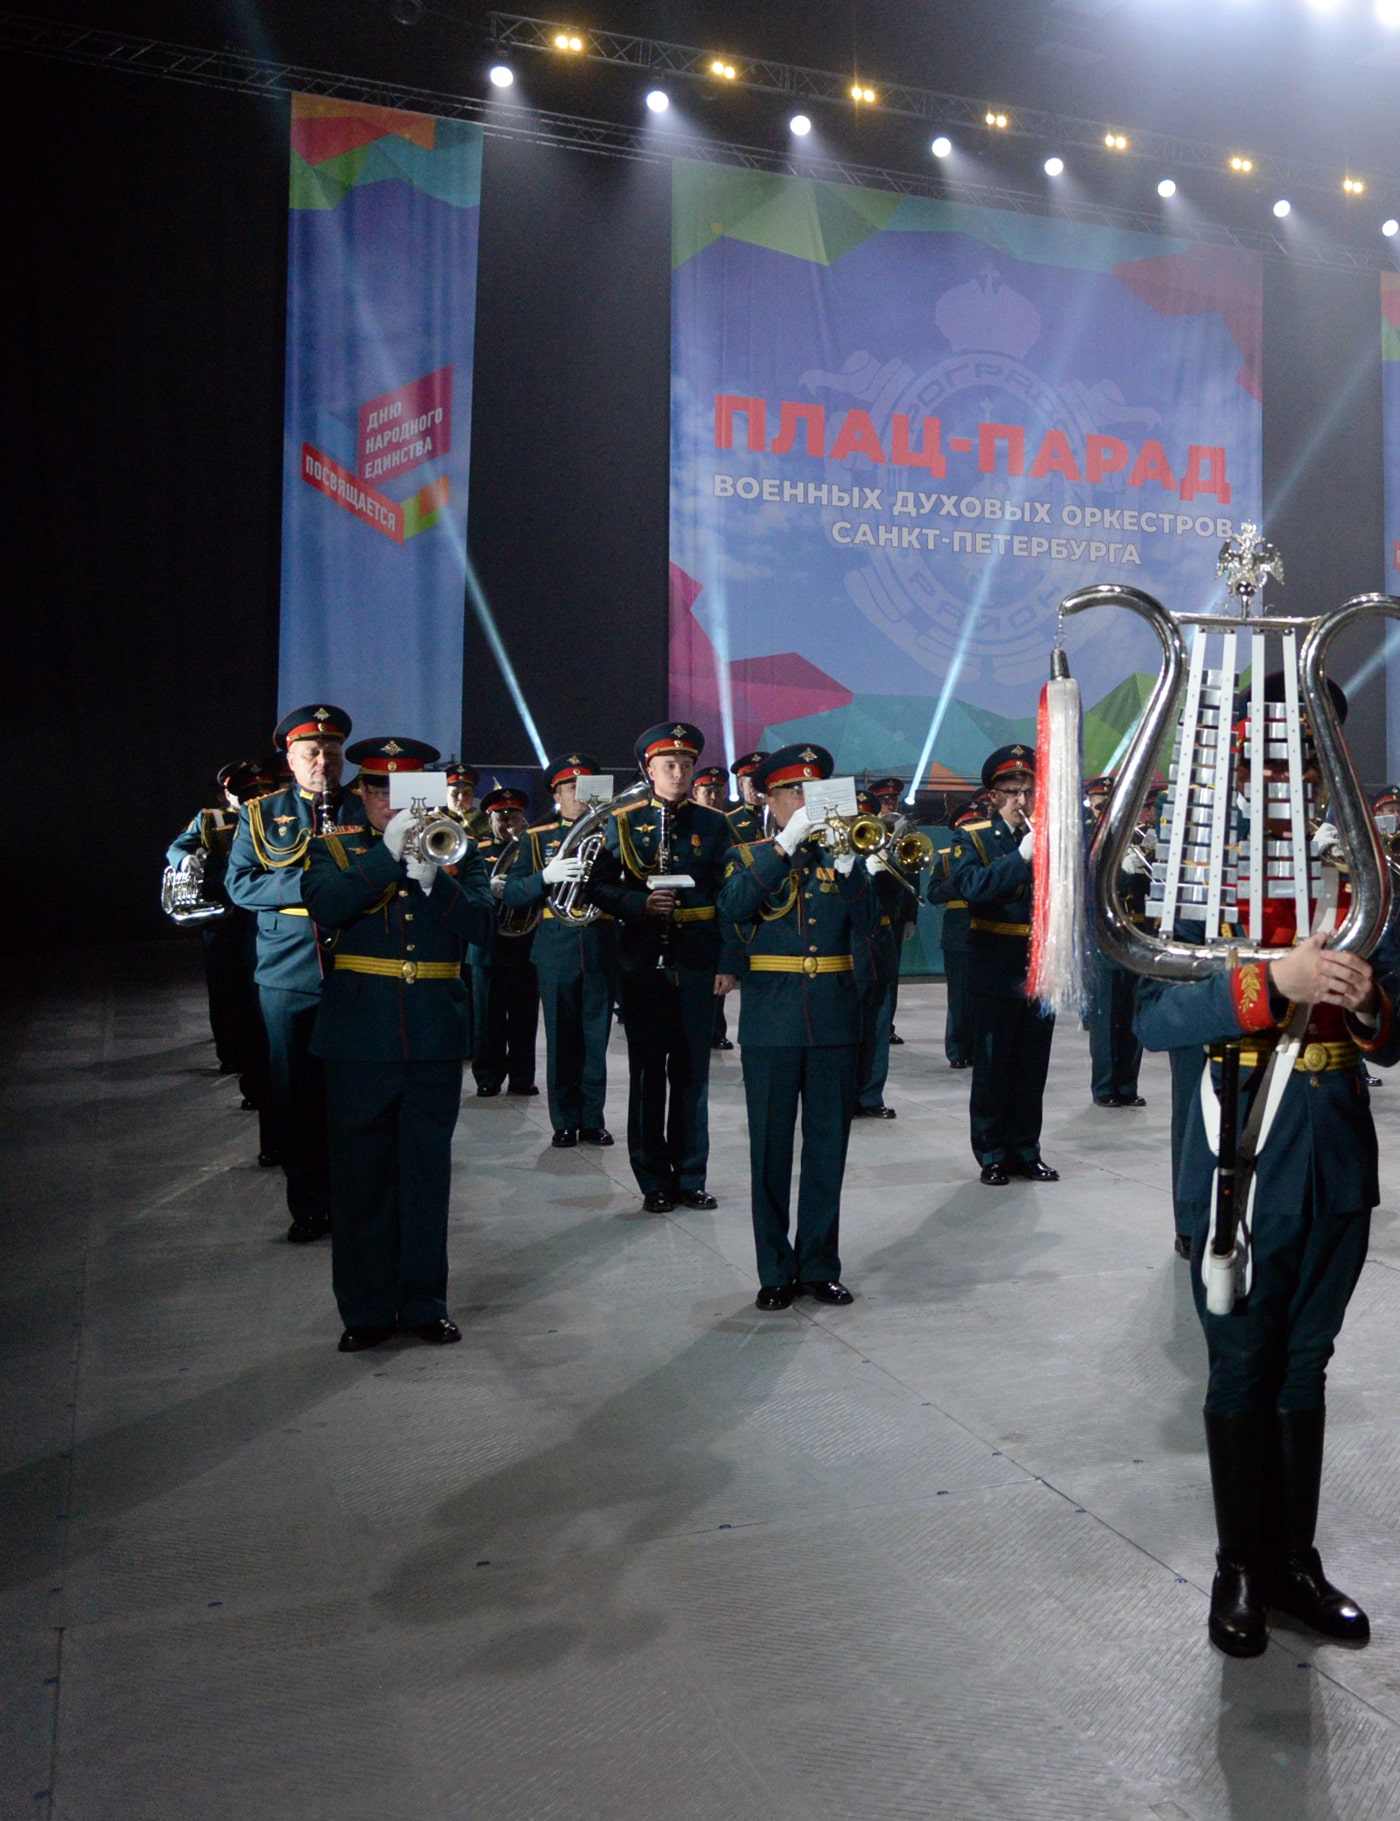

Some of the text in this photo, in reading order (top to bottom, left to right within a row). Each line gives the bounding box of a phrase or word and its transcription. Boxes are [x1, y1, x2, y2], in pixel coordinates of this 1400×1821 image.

[365, 407, 443, 455] НАРОДНОГО
[366, 401, 402, 432] ДНЮ
[364, 436, 433, 479] ЕДИНСТВА
[714, 393, 1231, 505] ПЛАЦ-ПАРАД
[305, 454, 396, 532] ПОСВЯЩАЕТСЯ
[713, 473, 1234, 540] ВОЕННЫХ ДУХОВЫХ ОРКЕСТРОВ
[831, 520, 1142, 566] САНКТ-ПЕТЕРБУРГА
